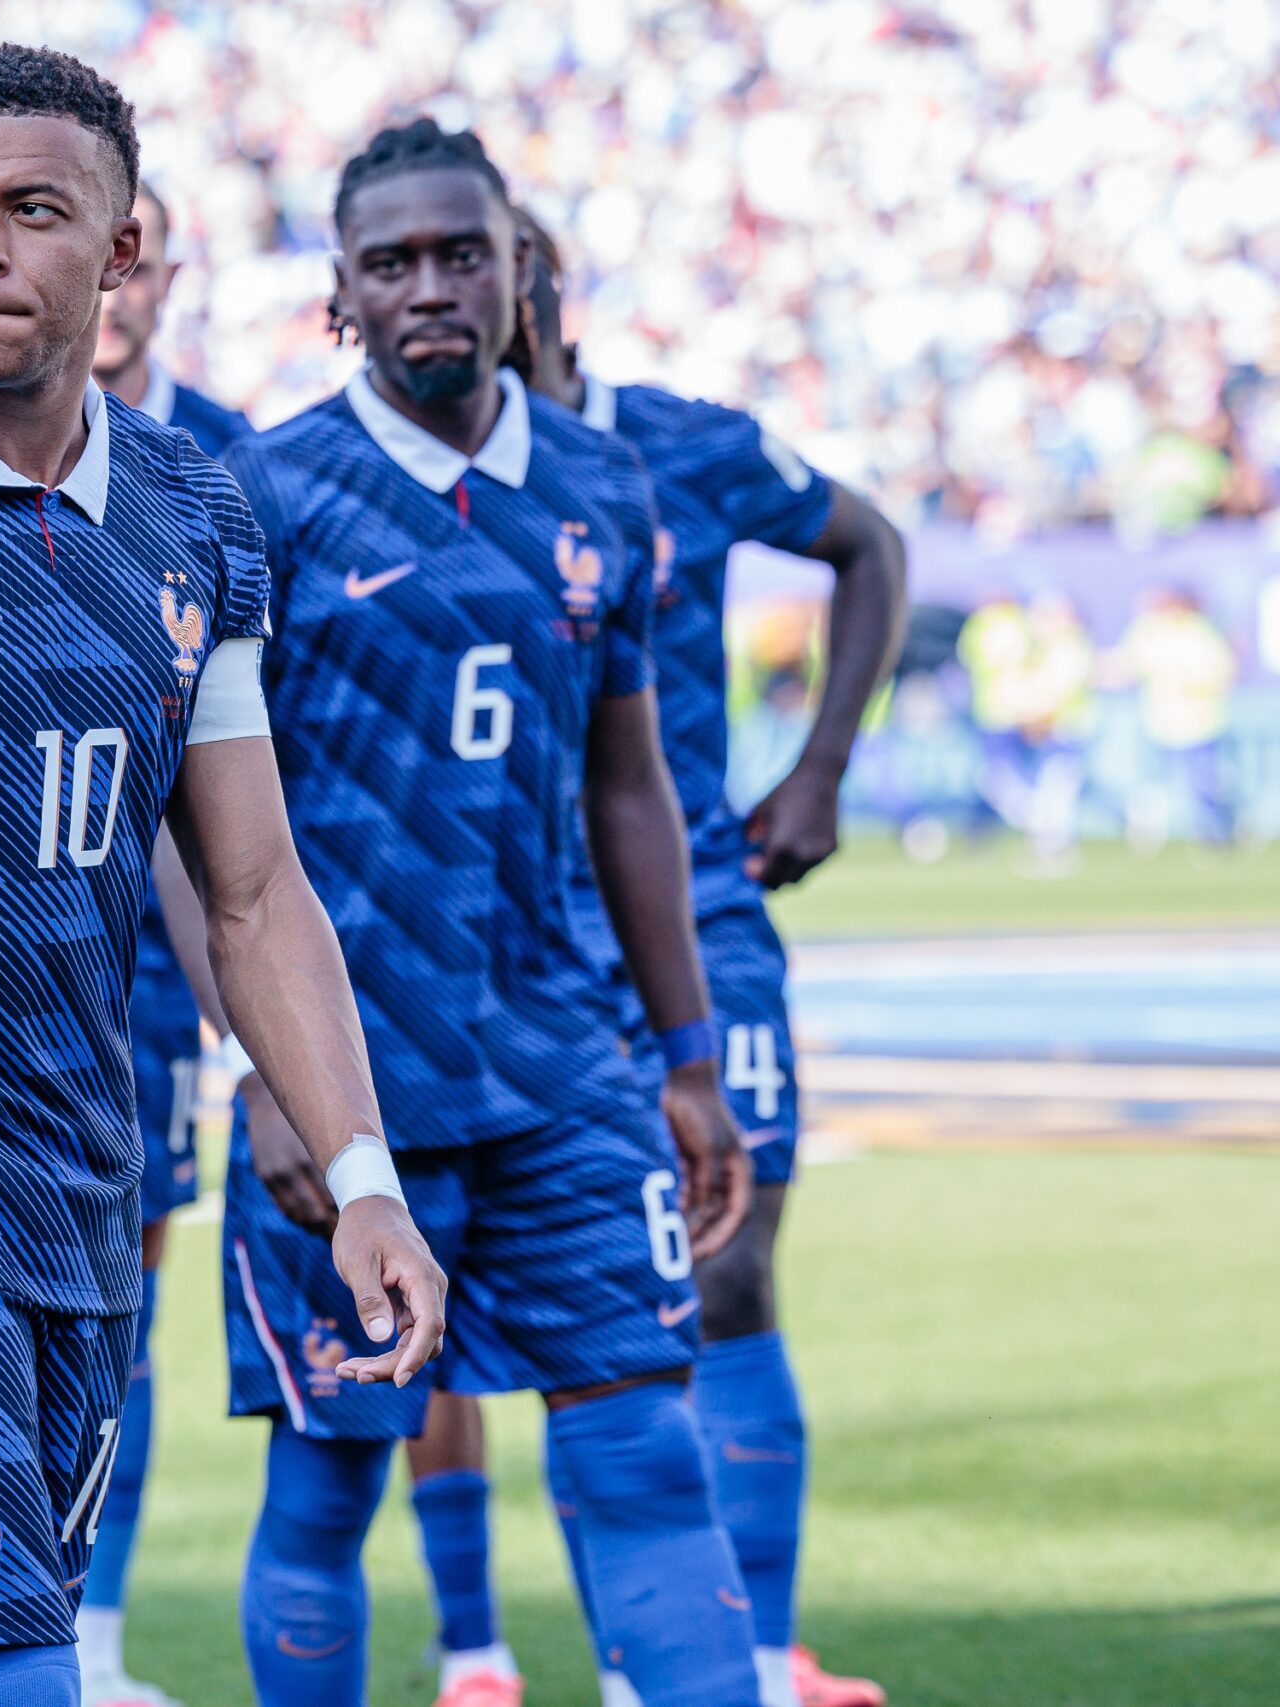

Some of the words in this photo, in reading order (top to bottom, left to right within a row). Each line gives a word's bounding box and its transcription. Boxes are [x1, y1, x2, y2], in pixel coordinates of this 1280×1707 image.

[449, 643, 514, 762] 6
[35, 727, 129, 869] 10
[724, 1022, 787, 1121] 4
[640, 1168, 693, 1282] 6
